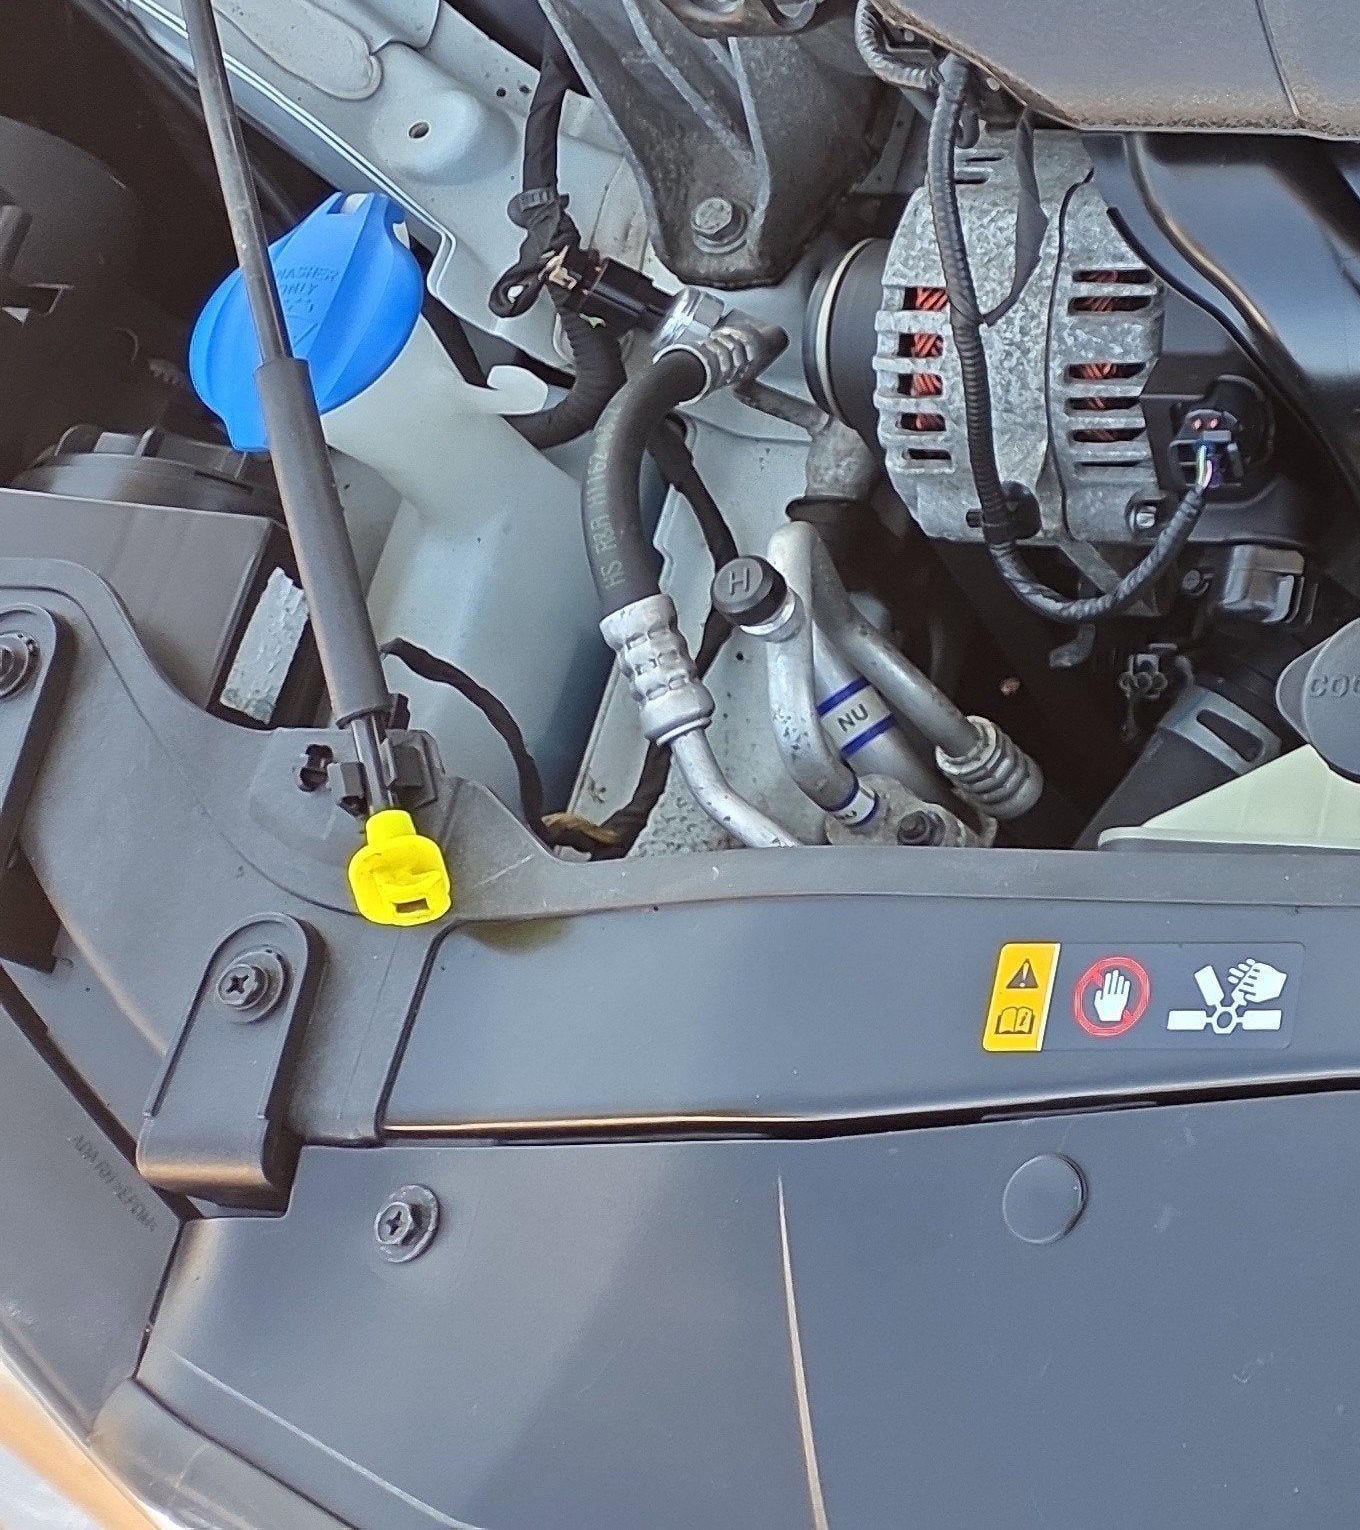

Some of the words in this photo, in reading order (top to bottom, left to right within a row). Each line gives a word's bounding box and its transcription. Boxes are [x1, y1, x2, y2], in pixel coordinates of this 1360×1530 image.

[601, 559, 626, 589] HS
[729, 567, 750, 595] H
[837, 703, 870, 732] NU
